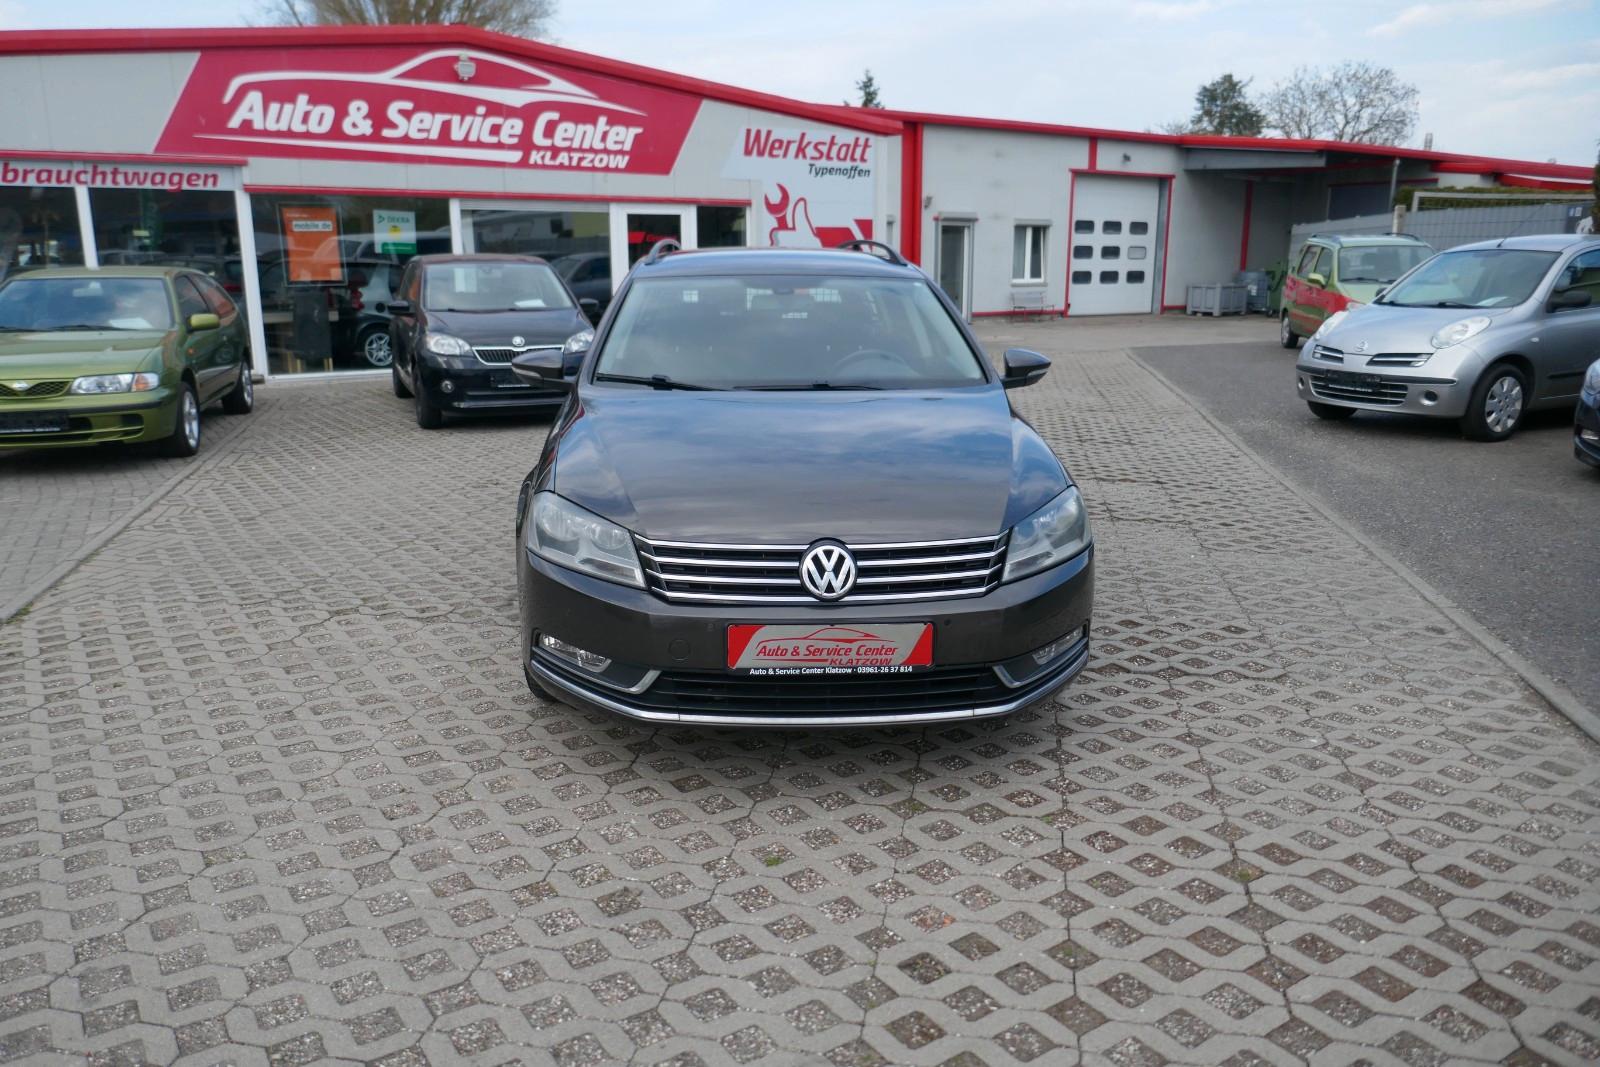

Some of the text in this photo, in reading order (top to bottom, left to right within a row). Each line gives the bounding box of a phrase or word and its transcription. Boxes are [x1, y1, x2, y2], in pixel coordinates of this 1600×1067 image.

[227, 91, 643, 151] Auto & Service Center
[744, 128, 872, 163] Werkstatt
[529, 150, 630, 169] KLATZOW
[1, 162, 219, 192] brauchtwagen
[808, 164, 871, 179] Typenoffen
[803, 546, 855, 598] VW
[756, 644, 898, 657] Auto & Service Center
[776, 667, 800, 675] Service
[825, 666, 853, 674] Klatzow
[857, 666, 889, 674] 03961-26
[829, 658, 893, 666] KLATZOW
